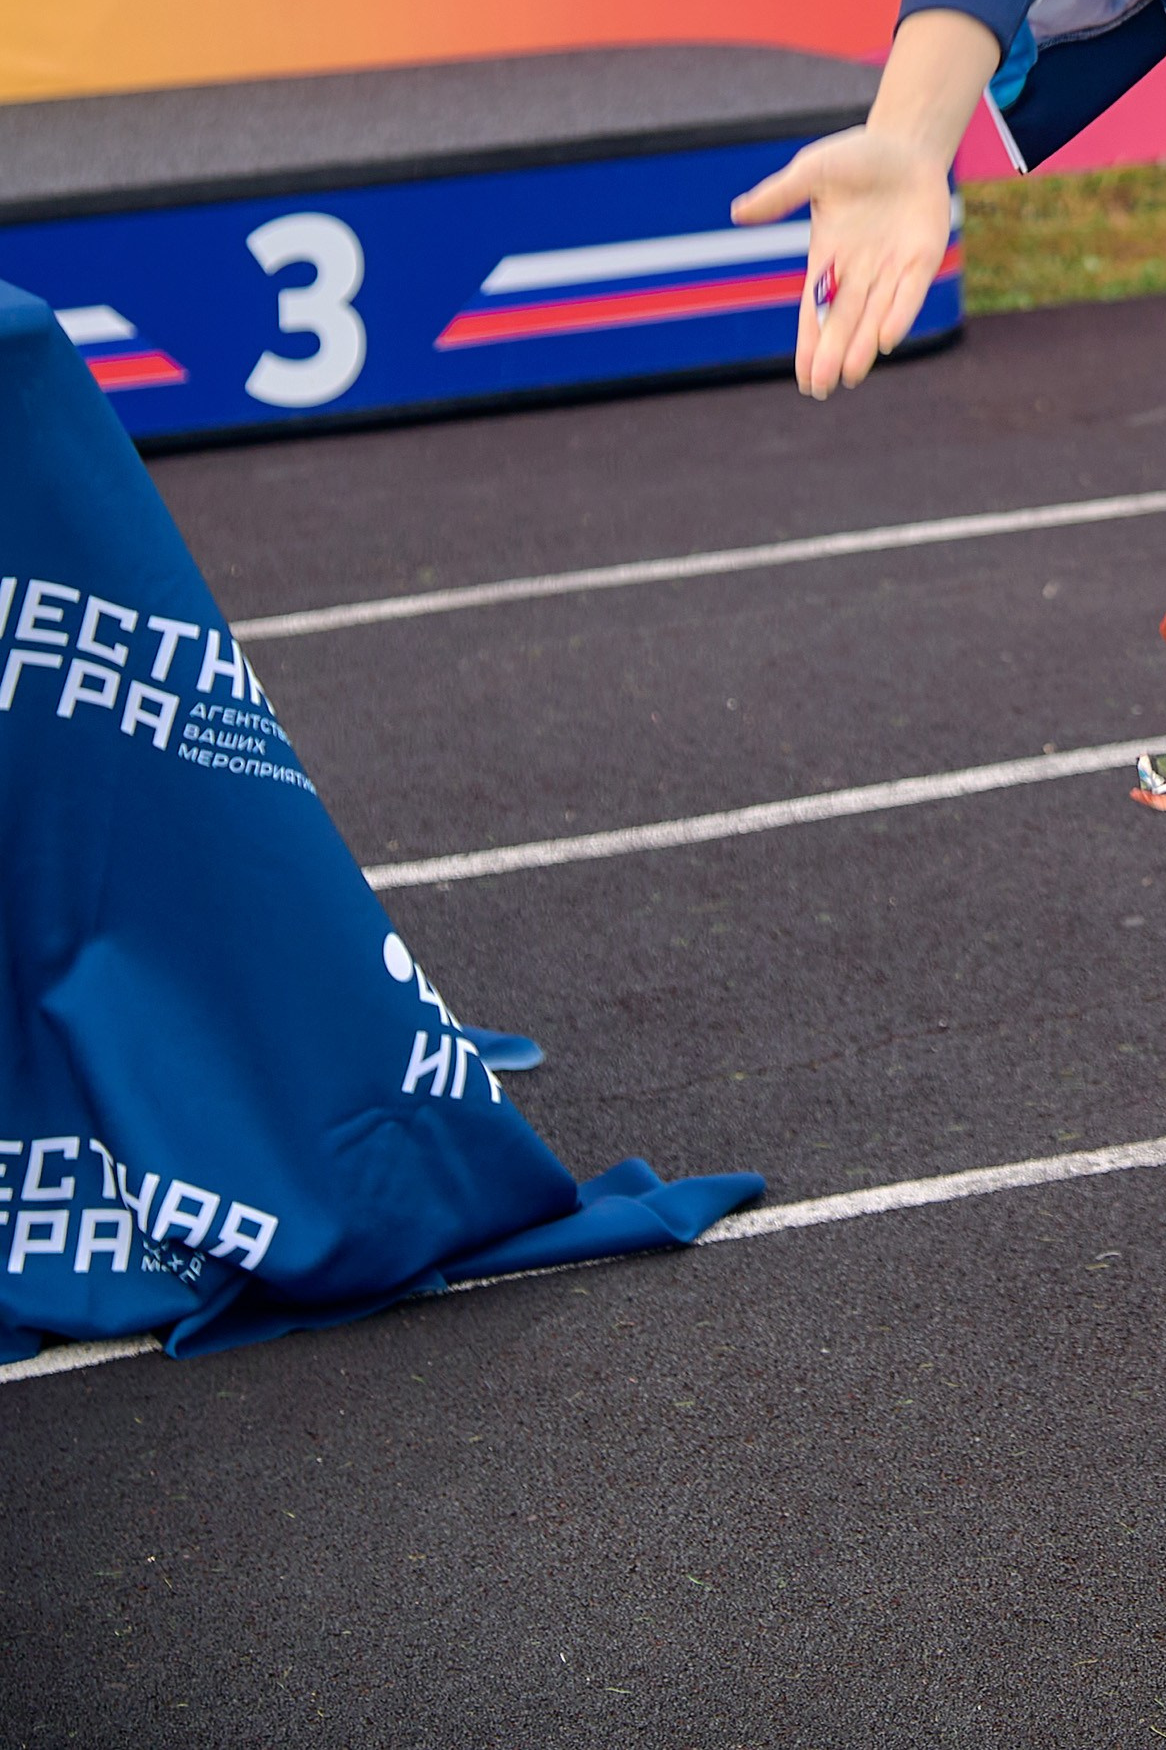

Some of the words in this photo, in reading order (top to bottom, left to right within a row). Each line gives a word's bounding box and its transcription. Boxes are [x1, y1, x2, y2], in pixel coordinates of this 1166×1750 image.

[244, 211, 367, 408] 3
[0, 576, 276, 717] ЕСТН
[177, 743, 317, 795] МЕРОПРИЯТИ
[183, 723, 266, 756] ВАШИХ
[0, 1207, 133, 1274] РА
